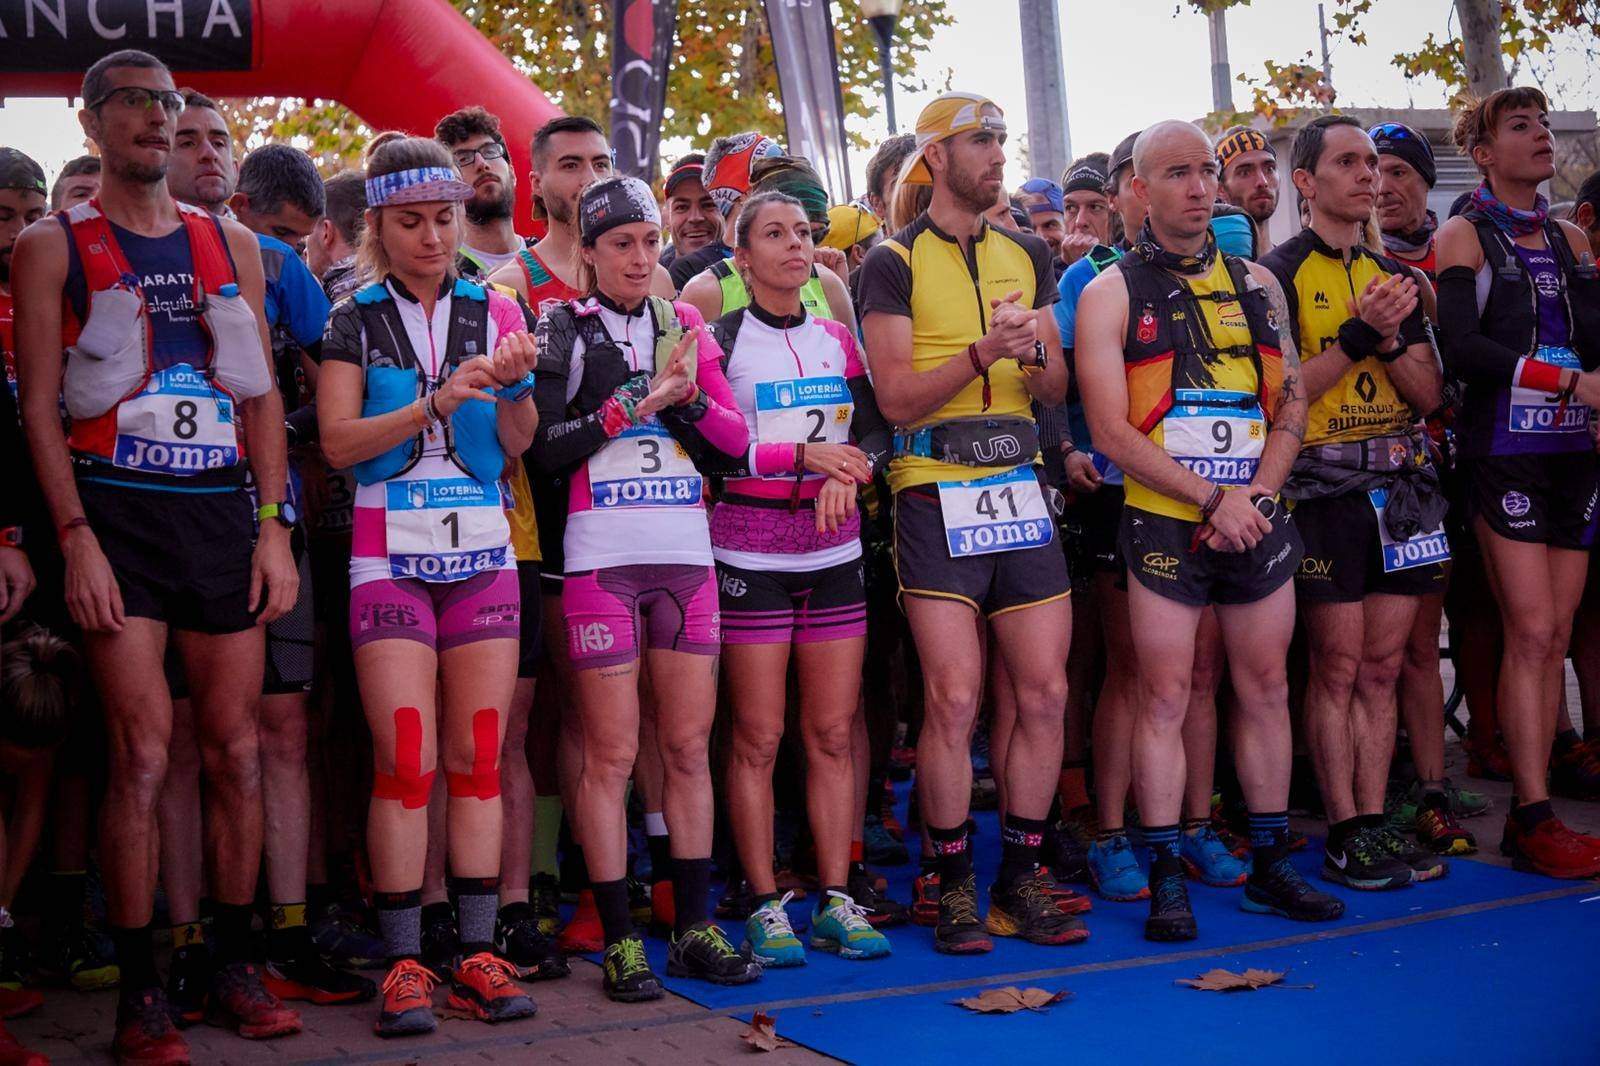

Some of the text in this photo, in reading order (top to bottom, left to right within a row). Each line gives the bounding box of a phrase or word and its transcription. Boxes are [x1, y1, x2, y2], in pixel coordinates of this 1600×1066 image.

[173, 400, 197, 439] 8
[837, 409, 848, 420] 35
[1340, 404, 1393, 414] RENAULT
[806, 409, 827, 444] 2
[1211, 420, 1232, 454] 9
[1250, 425, 1260, 436] 35
[637, 439, 662, 474] 3
[976, 486, 1018, 520] 41
[441, 512, 459, 548] 1
